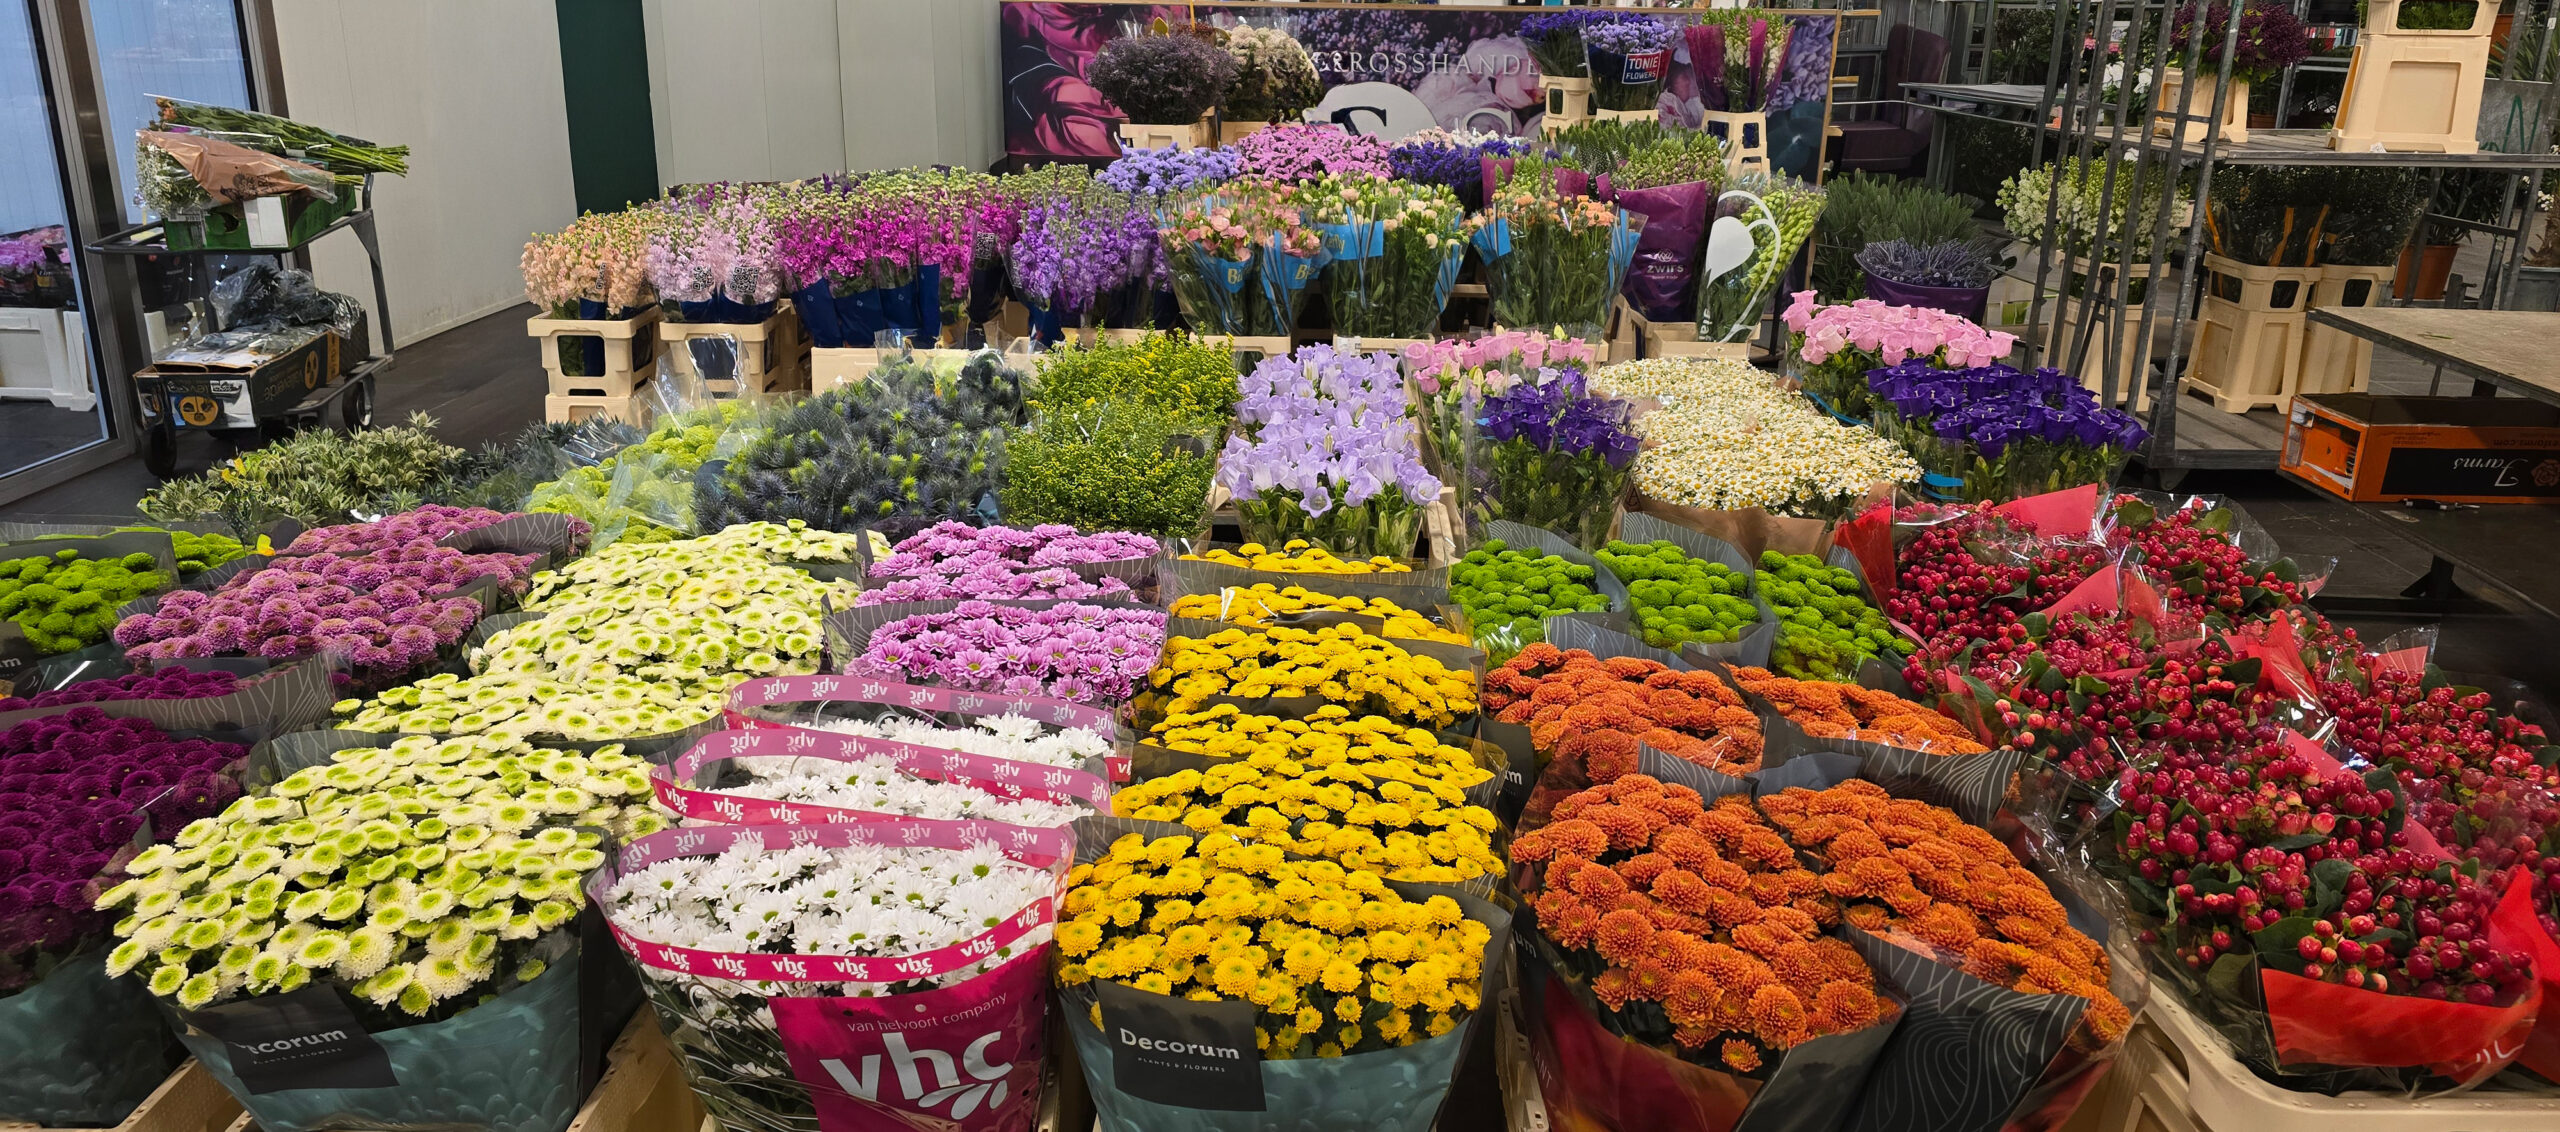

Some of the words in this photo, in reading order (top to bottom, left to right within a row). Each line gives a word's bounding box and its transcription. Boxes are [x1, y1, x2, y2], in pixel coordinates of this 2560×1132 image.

[1625, 70, 1657, 80] FLOWERS
[1628, 56, 1659, 70] TONIE
[2453, 457, 2528, 487] Farms
[665, 788, 688, 807] vhc
[713, 798, 744, 816] vhc
[770, 804, 800, 821] vhc
[617, 931, 639, 953] vhc
[658, 947, 688, 966] vhc
[712, 955, 747, 972] vhc
[772, 957, 807, 974] vhc
[833, 959, 868, 975] vhc
[895, 957, 933, 974] vhc
[960, 935, 995, 957] vhc
[1017, 903, 1040, 928] vhc
[847, 1021, 875, 1032] van
[878, 1015, 939, 1031] helvoort
[943, 992, 1008, 1024] company
[240, 1030, 348, 1054] ecorum
[1120, 1027, 1240, 1059] Decorum
[819, 1031, 1013, 1101] vhc
[1137, 1057, 1170, 1067] PLANTS
[1184, 1064, 1226, 1072] FLOWERS
